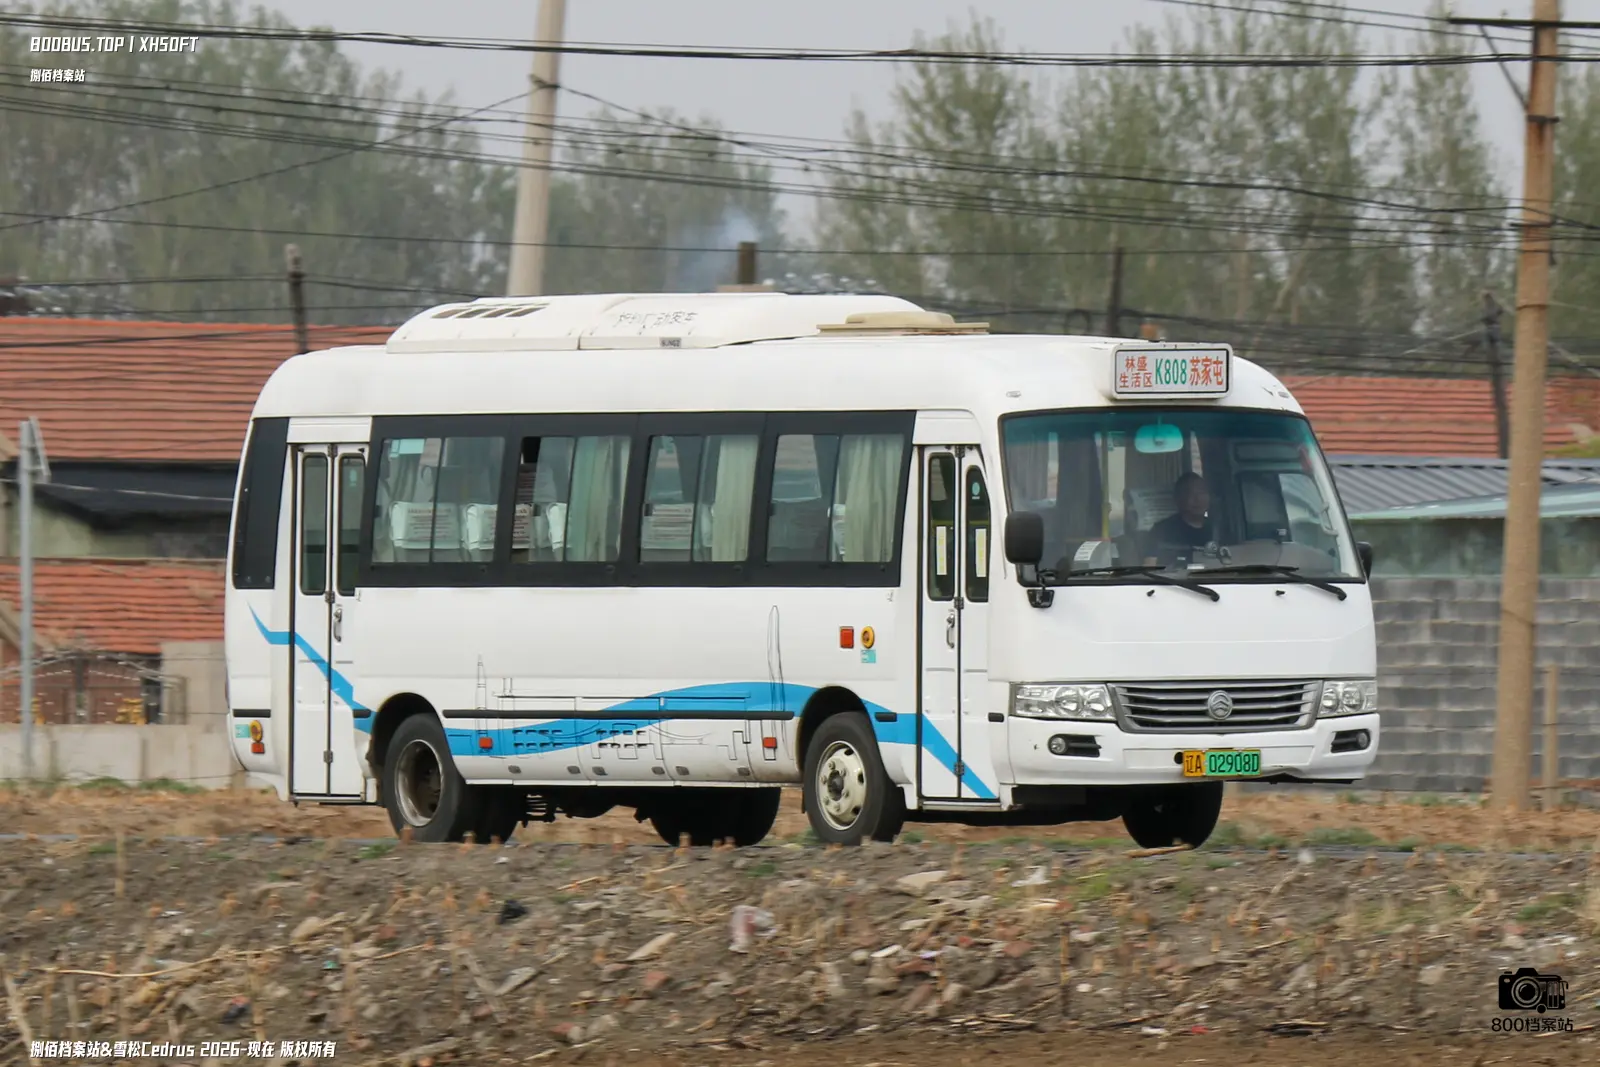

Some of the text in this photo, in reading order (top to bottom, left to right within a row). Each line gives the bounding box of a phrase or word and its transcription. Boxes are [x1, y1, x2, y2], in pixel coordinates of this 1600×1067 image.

[1125, 356, 1147, 371] 林盛
[1155, 356, 1223, 386] K808 苏家屯
[1119, 373, 1152, 388] 生活区
[1209, 754, 1259, 772] 02908D
